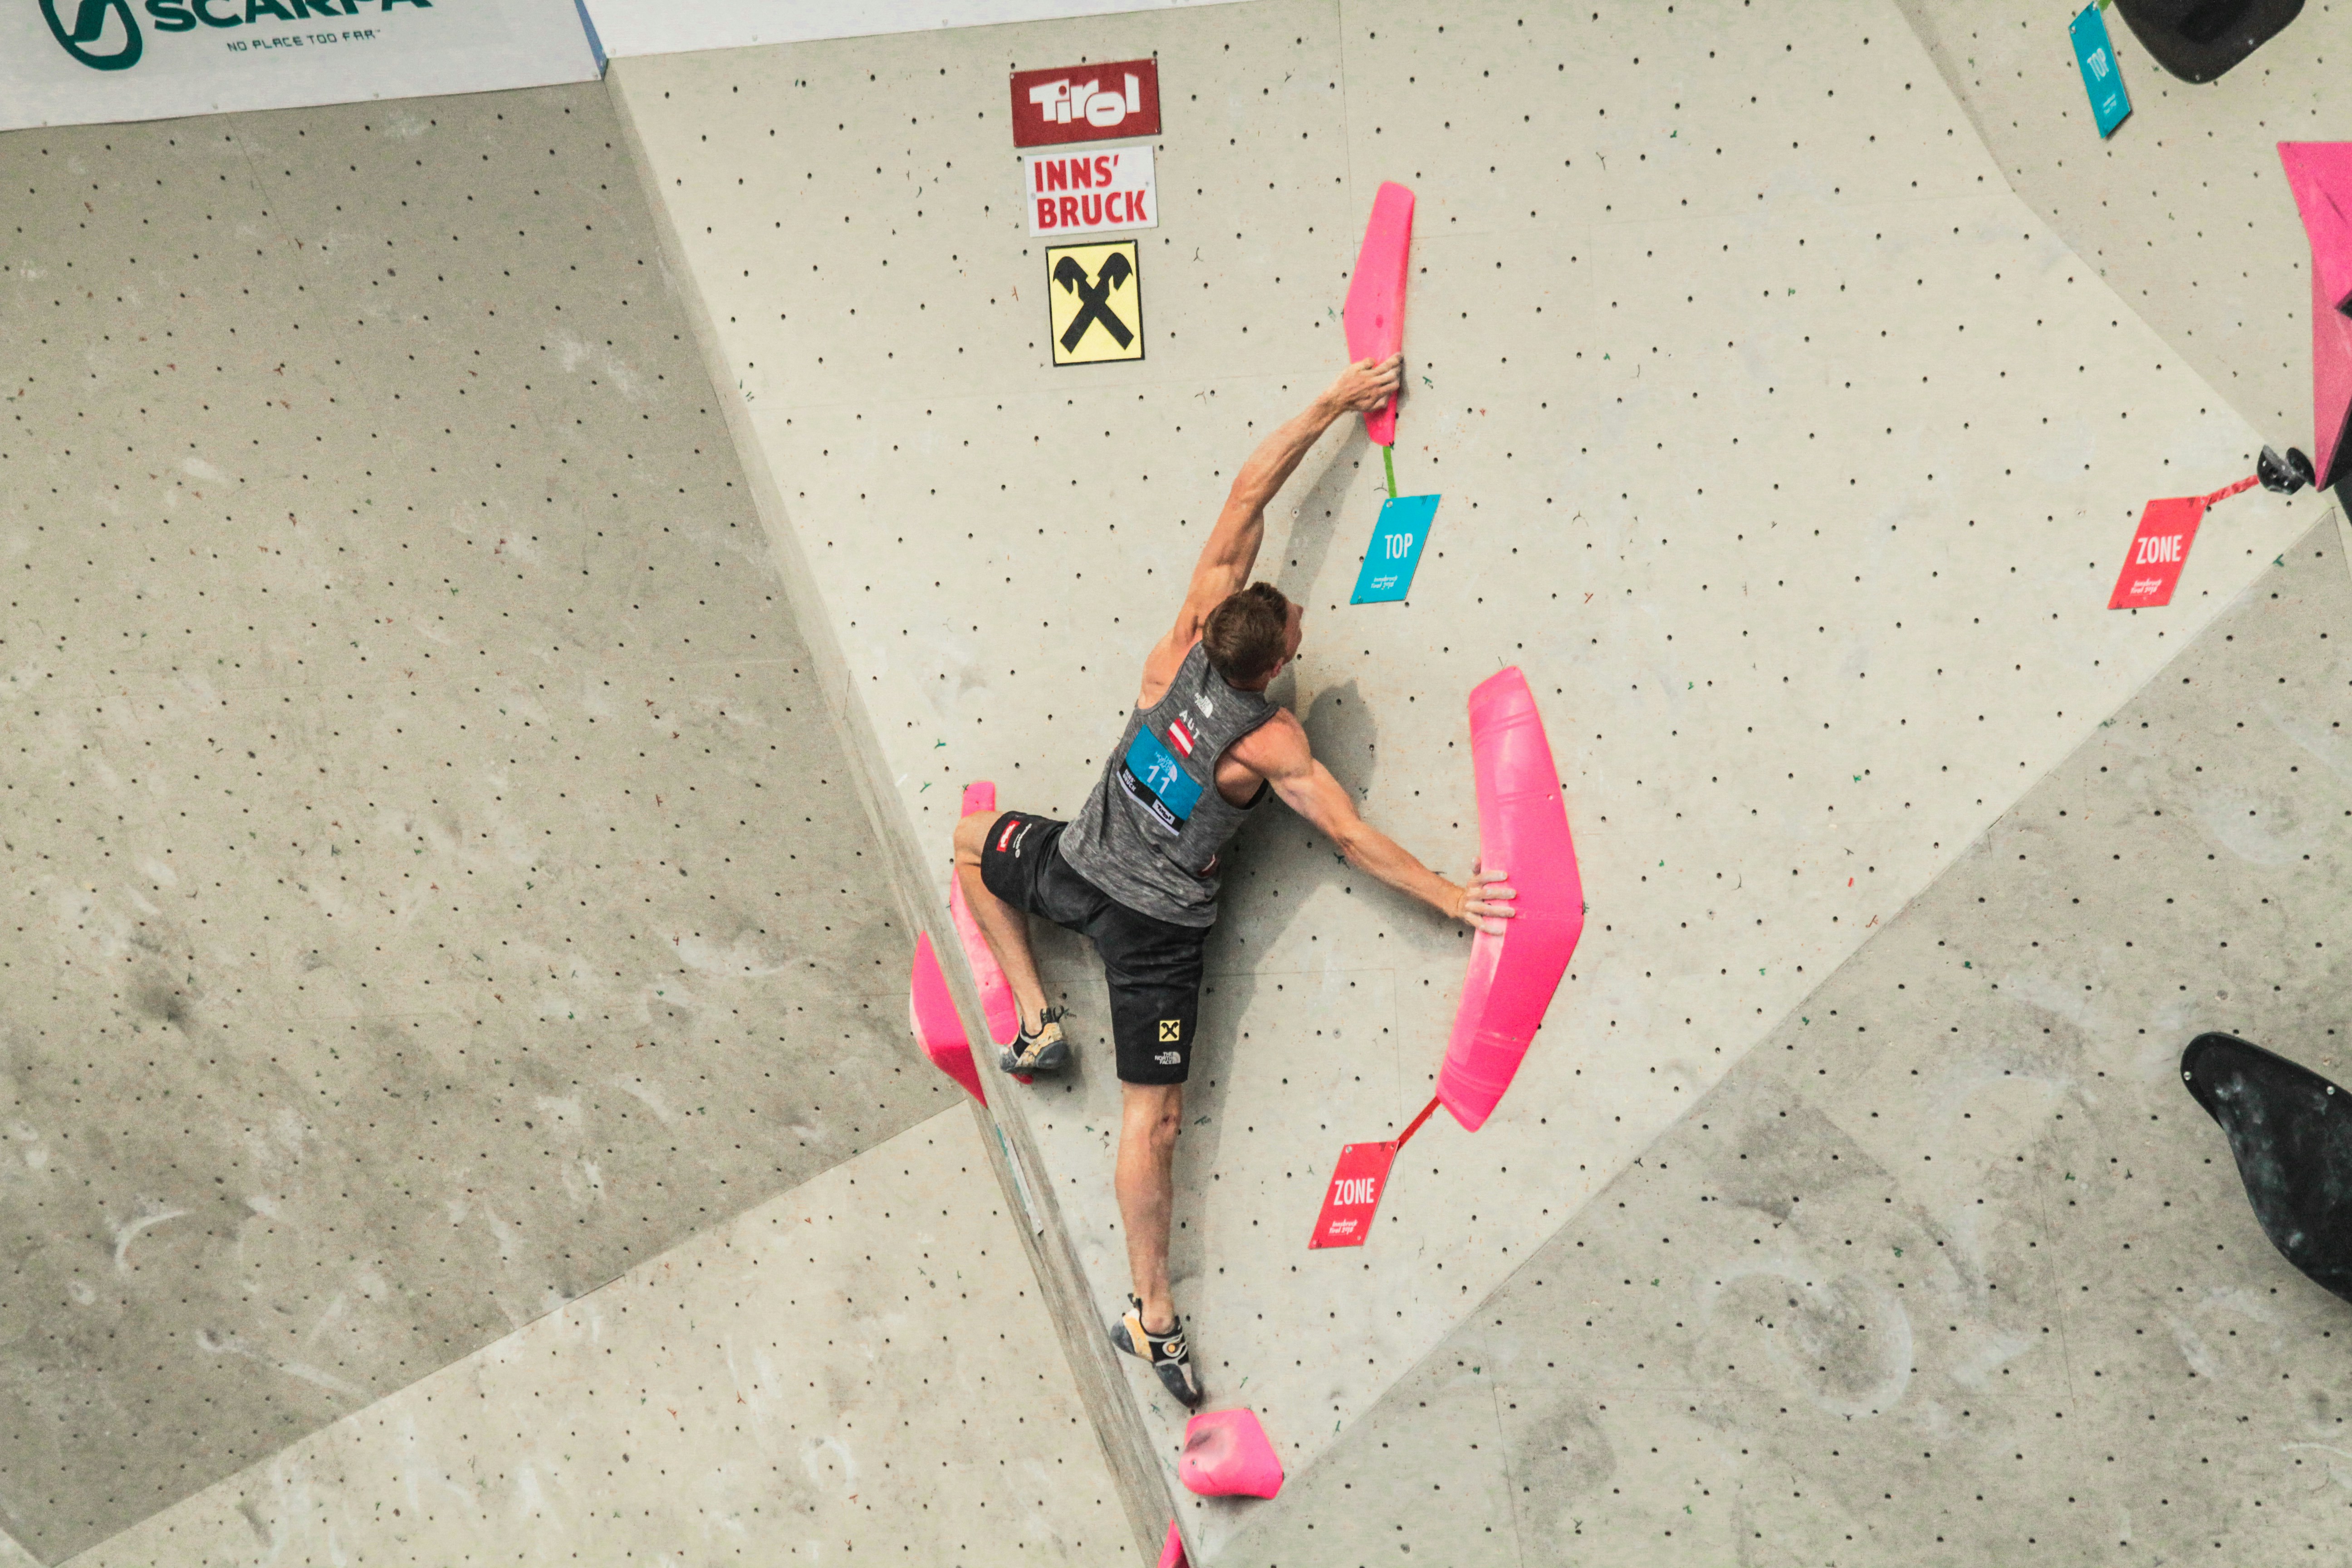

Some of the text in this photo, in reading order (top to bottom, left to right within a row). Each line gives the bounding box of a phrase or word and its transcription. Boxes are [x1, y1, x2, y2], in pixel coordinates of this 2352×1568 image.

[227, 41, 247, 51] NO
[252, 36, 304, 49] PLACE
[307, 33, 338, 44] TOO
[2087, 48, 2109, 82] TOP
[1029, 73, 1141, 127] Tirol
[1037, 190, 1147, 230] BRUCK
[1384, 533, 1413, 559] TOP
[2136, 535, 2183, 564] ZONE
[1179, 710, 1200, 740] AUT
[1147, 765, 1171, 794] 11
[1333, 1178, 1375, 1205] ZONE
